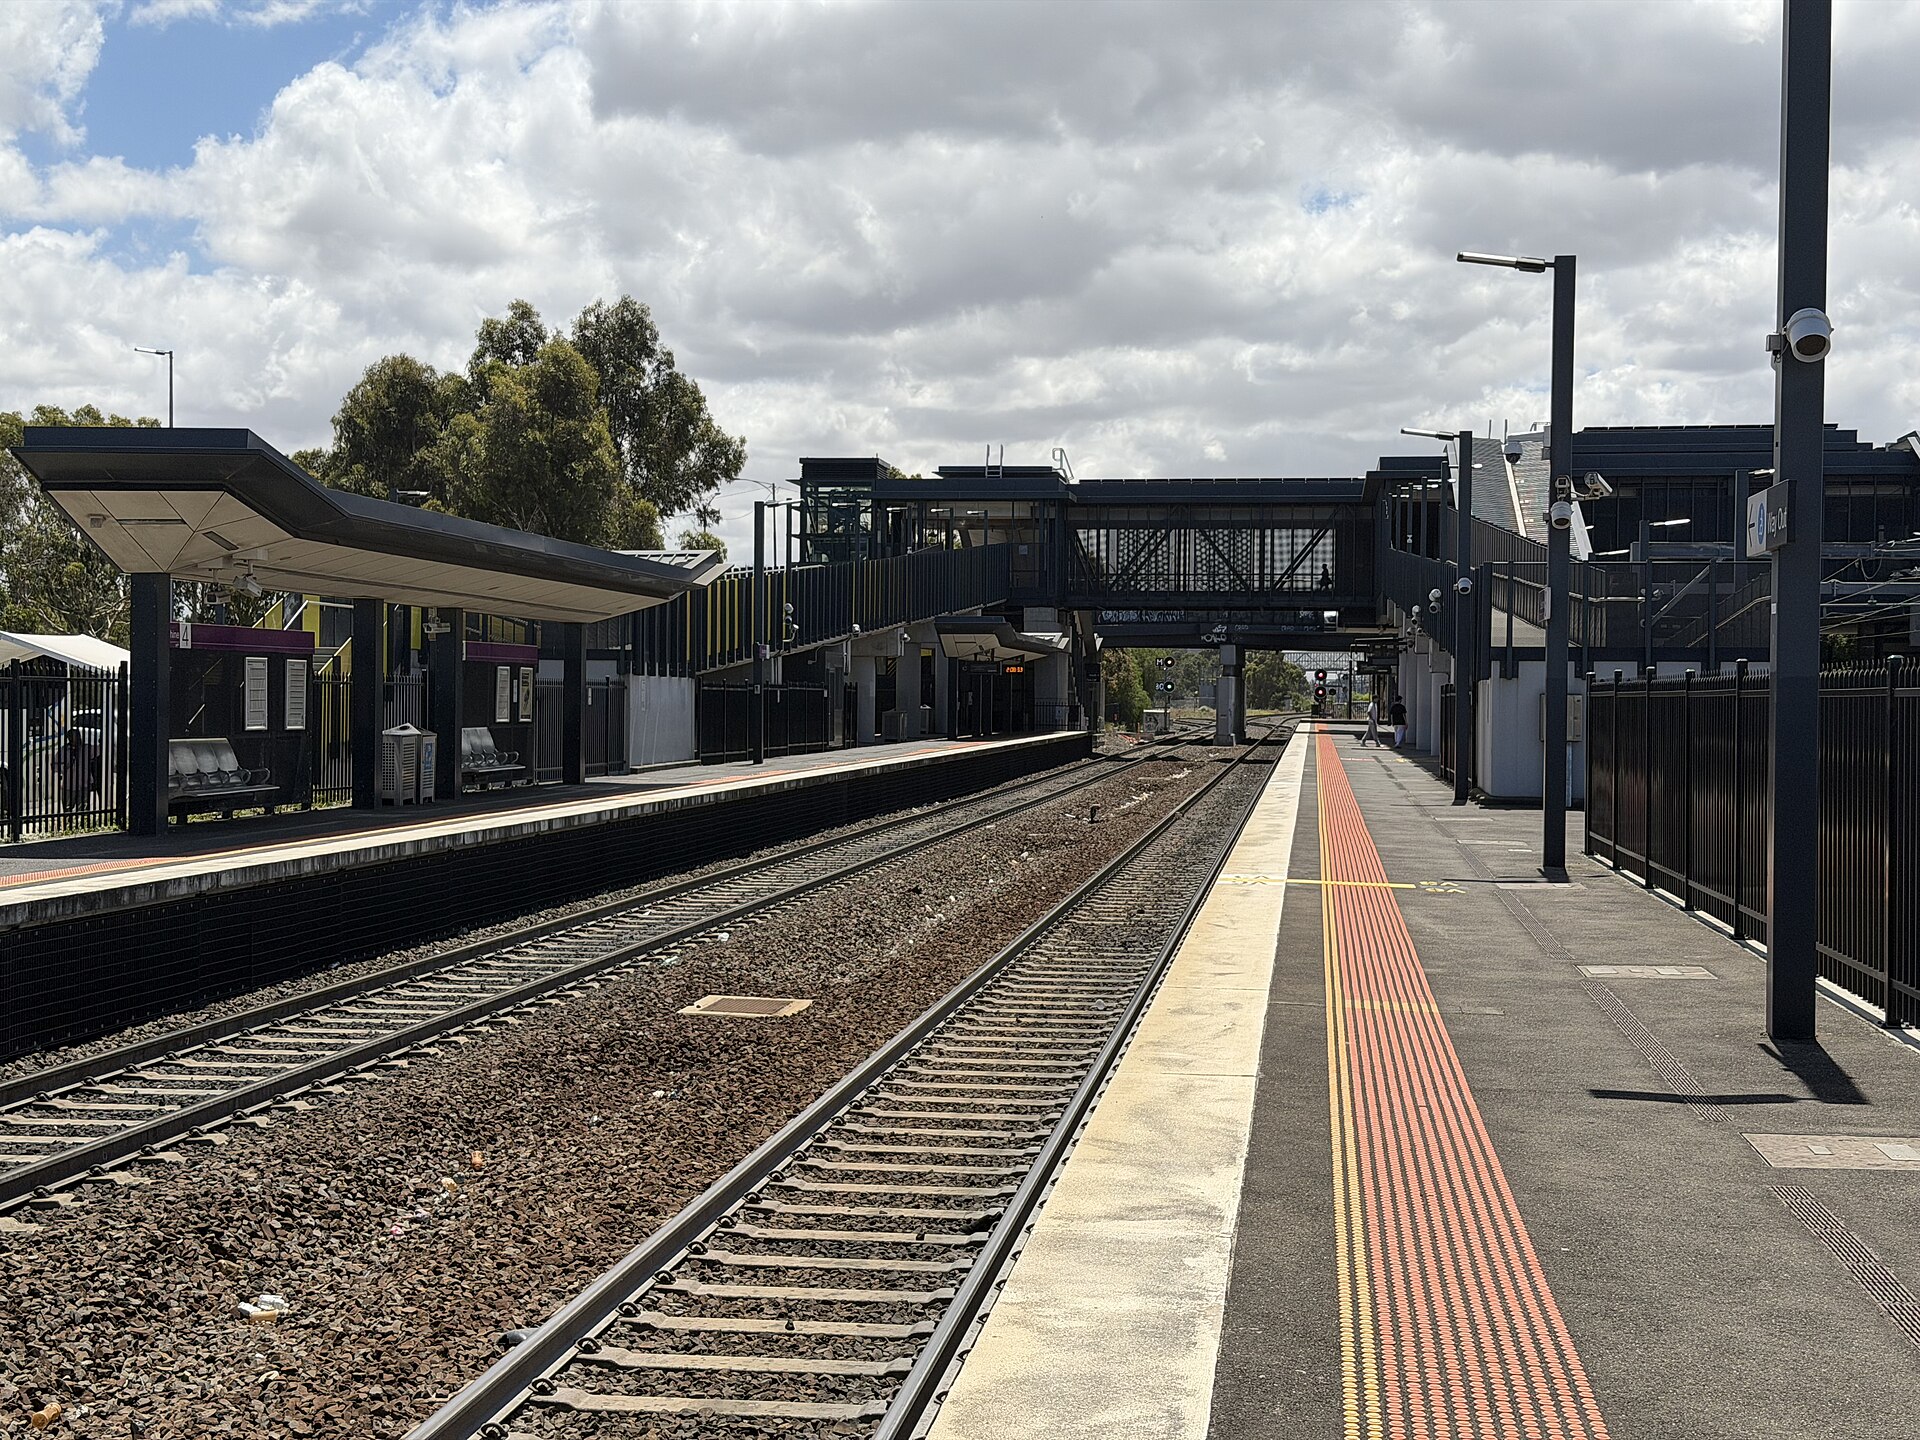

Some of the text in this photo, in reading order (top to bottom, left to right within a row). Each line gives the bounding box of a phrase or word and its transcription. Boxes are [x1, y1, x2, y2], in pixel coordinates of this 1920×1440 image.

[1767, 507, 1787, 538] Way Out
[169, 629, 179, 640] hine
[182, 624, 189, 647] 4
[1156, 658, 1163, 666] M
